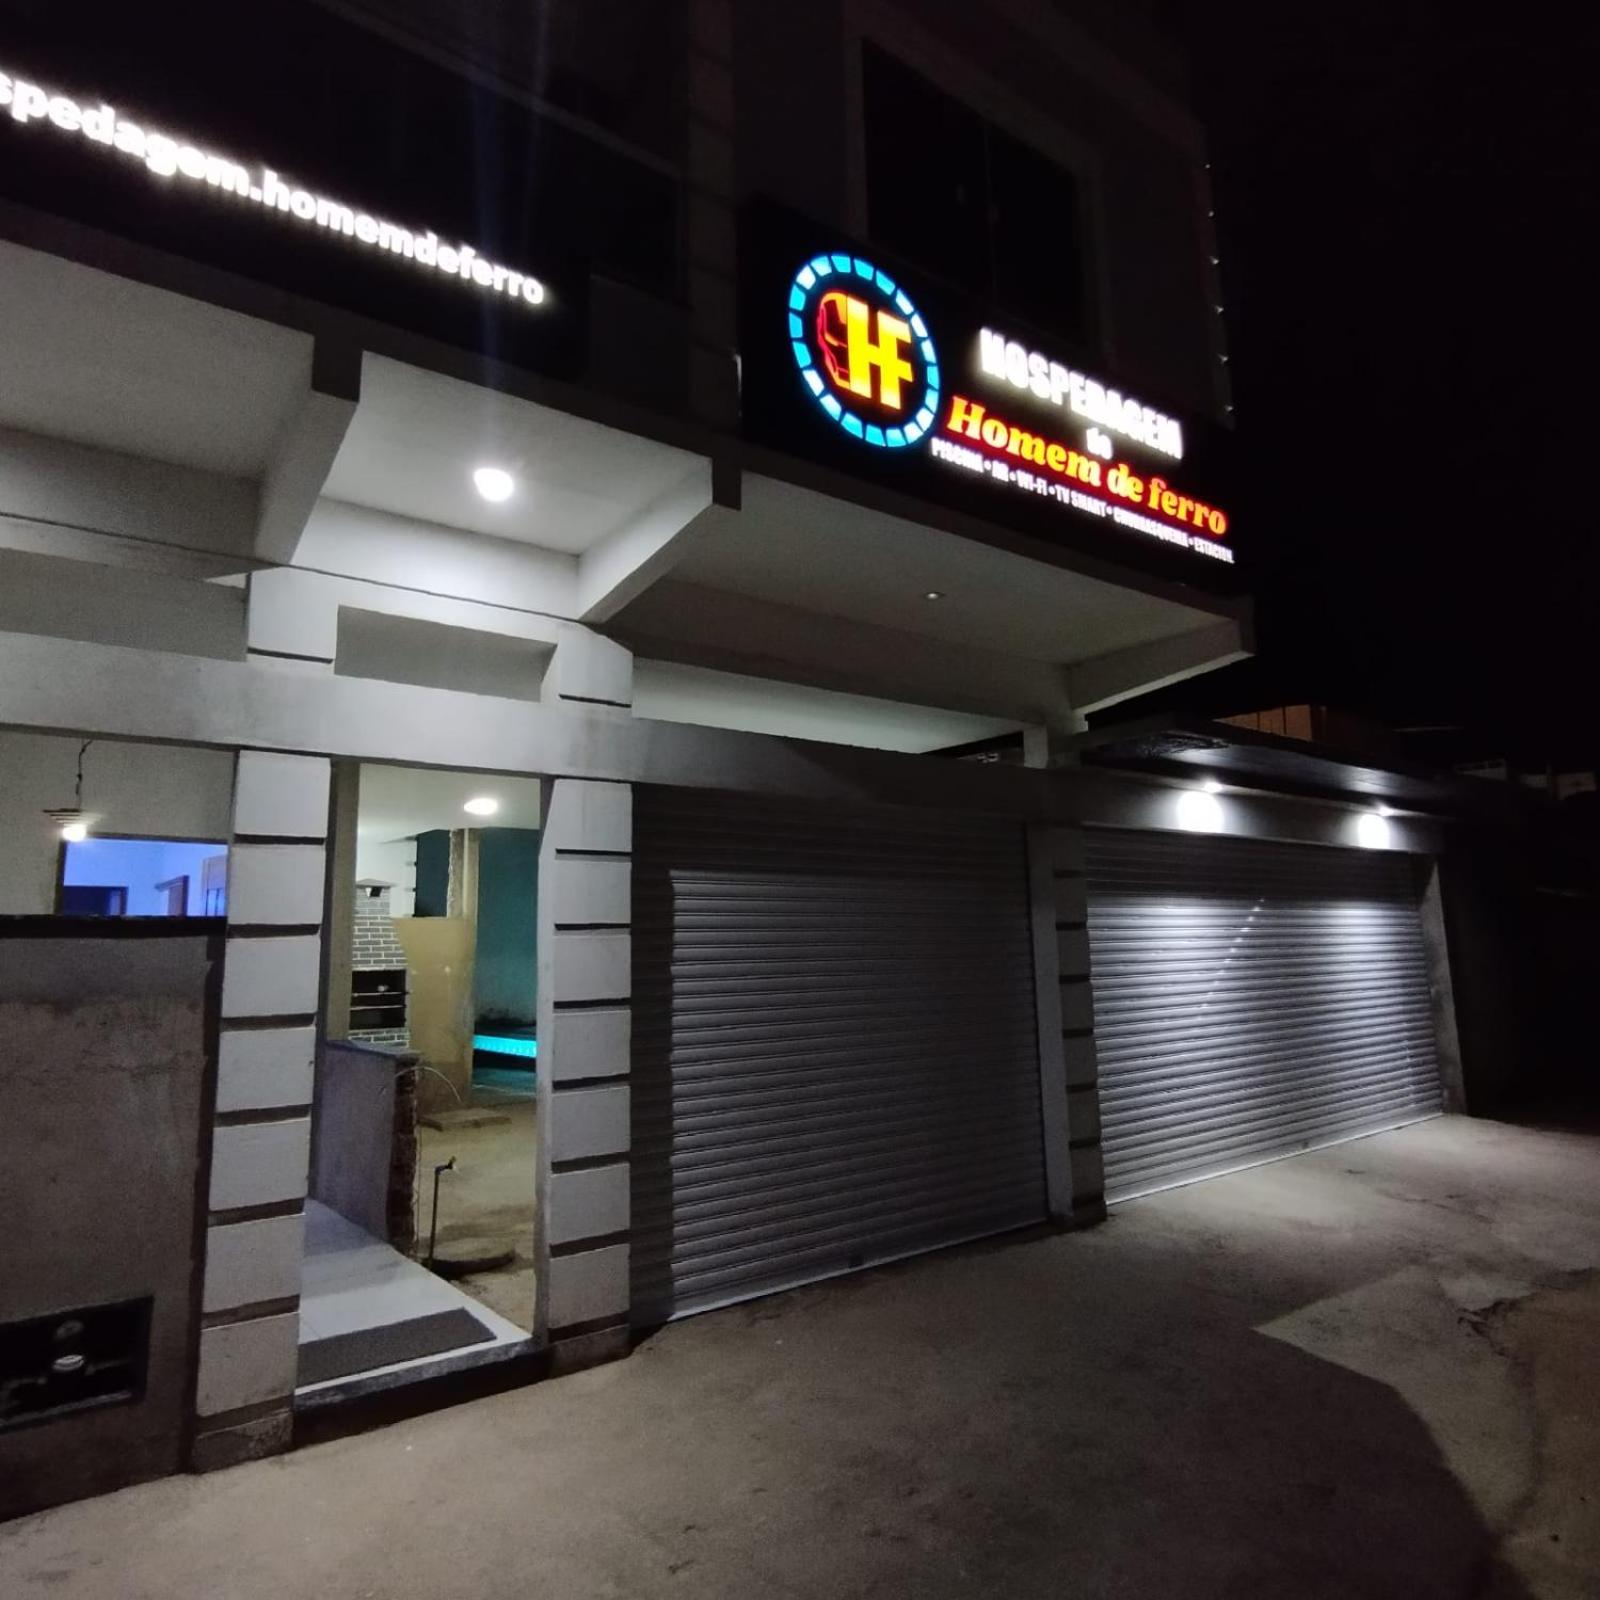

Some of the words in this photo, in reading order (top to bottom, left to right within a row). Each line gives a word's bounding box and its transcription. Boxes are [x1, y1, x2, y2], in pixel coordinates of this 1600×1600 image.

[979, 327, 1183, 460] HOSPEDAGEM
[947, 396, 1101, 488] Homem
[1106, 463, 1144, 503] de
[1148, 477, 1227, 535] ferro
[1055, 484, 1070, 504] TV
[1070, 490, 1107, 517] SMART
